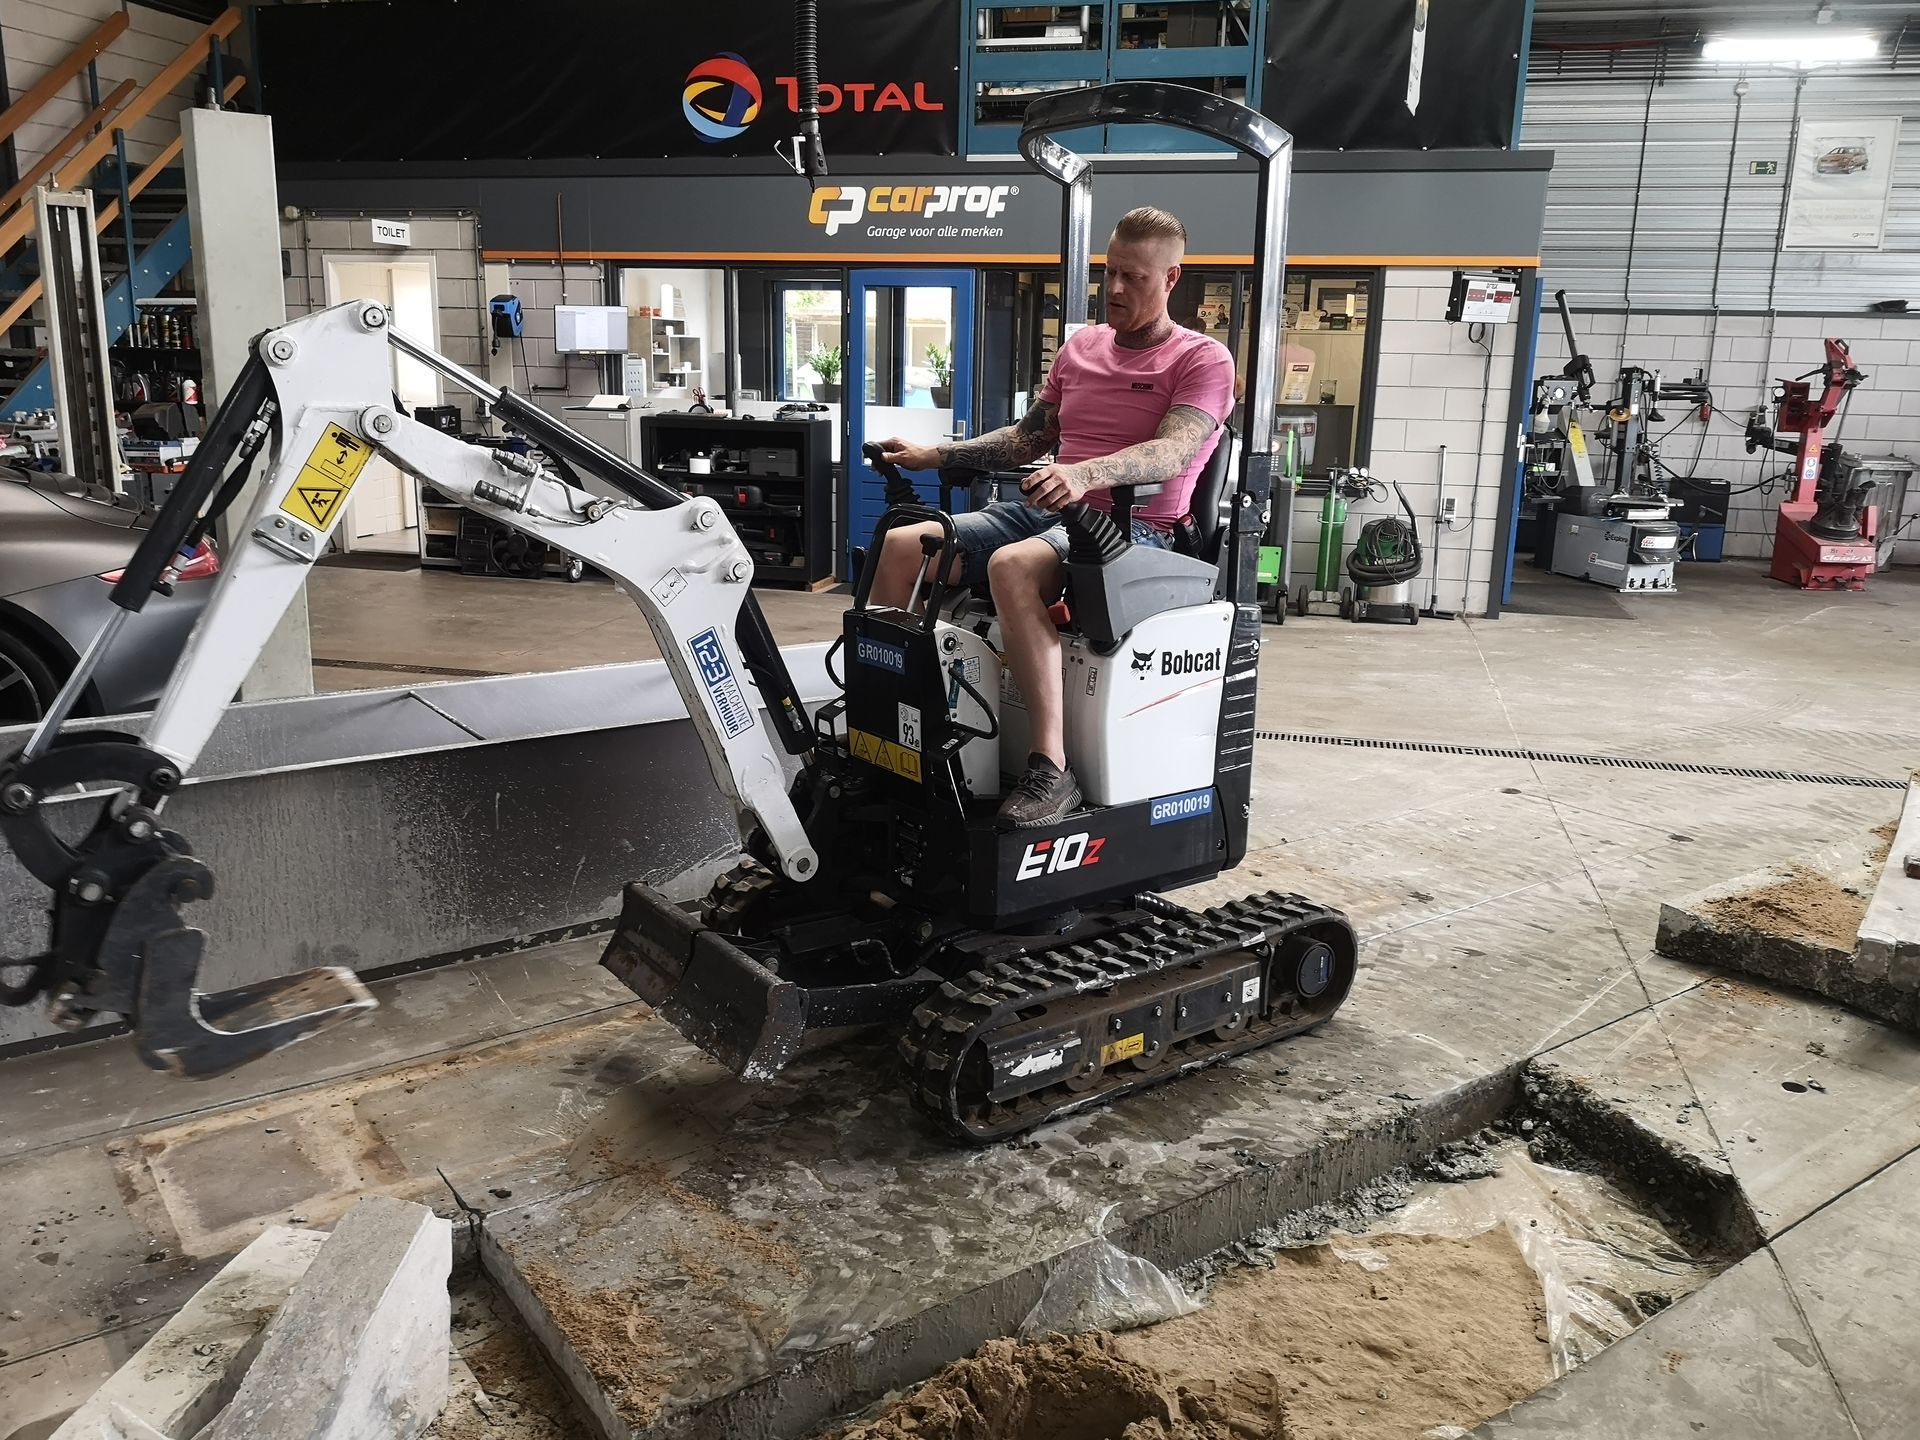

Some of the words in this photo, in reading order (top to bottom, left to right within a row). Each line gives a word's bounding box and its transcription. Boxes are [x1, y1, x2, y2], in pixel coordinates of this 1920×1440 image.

[775, 76, 944, 113] TOTAL
[376, 226, 406, 239] TOILET
[866, 225, 906, 240] Garage
[909, 227, 935, 238] voor
[937, 225, 959, 238] alle
[960, 225, 1004, 238] merken
[857, 642, 903, 669] GR010019
[1161, 647, 1221, 676] Bobcat
[712, 685, 740, 735] VERHUUR
[722, 679, 751, 729] MACHINE
[903, 722, 914, 746] 93
[1152, 793, 1211, 821] GR010019
